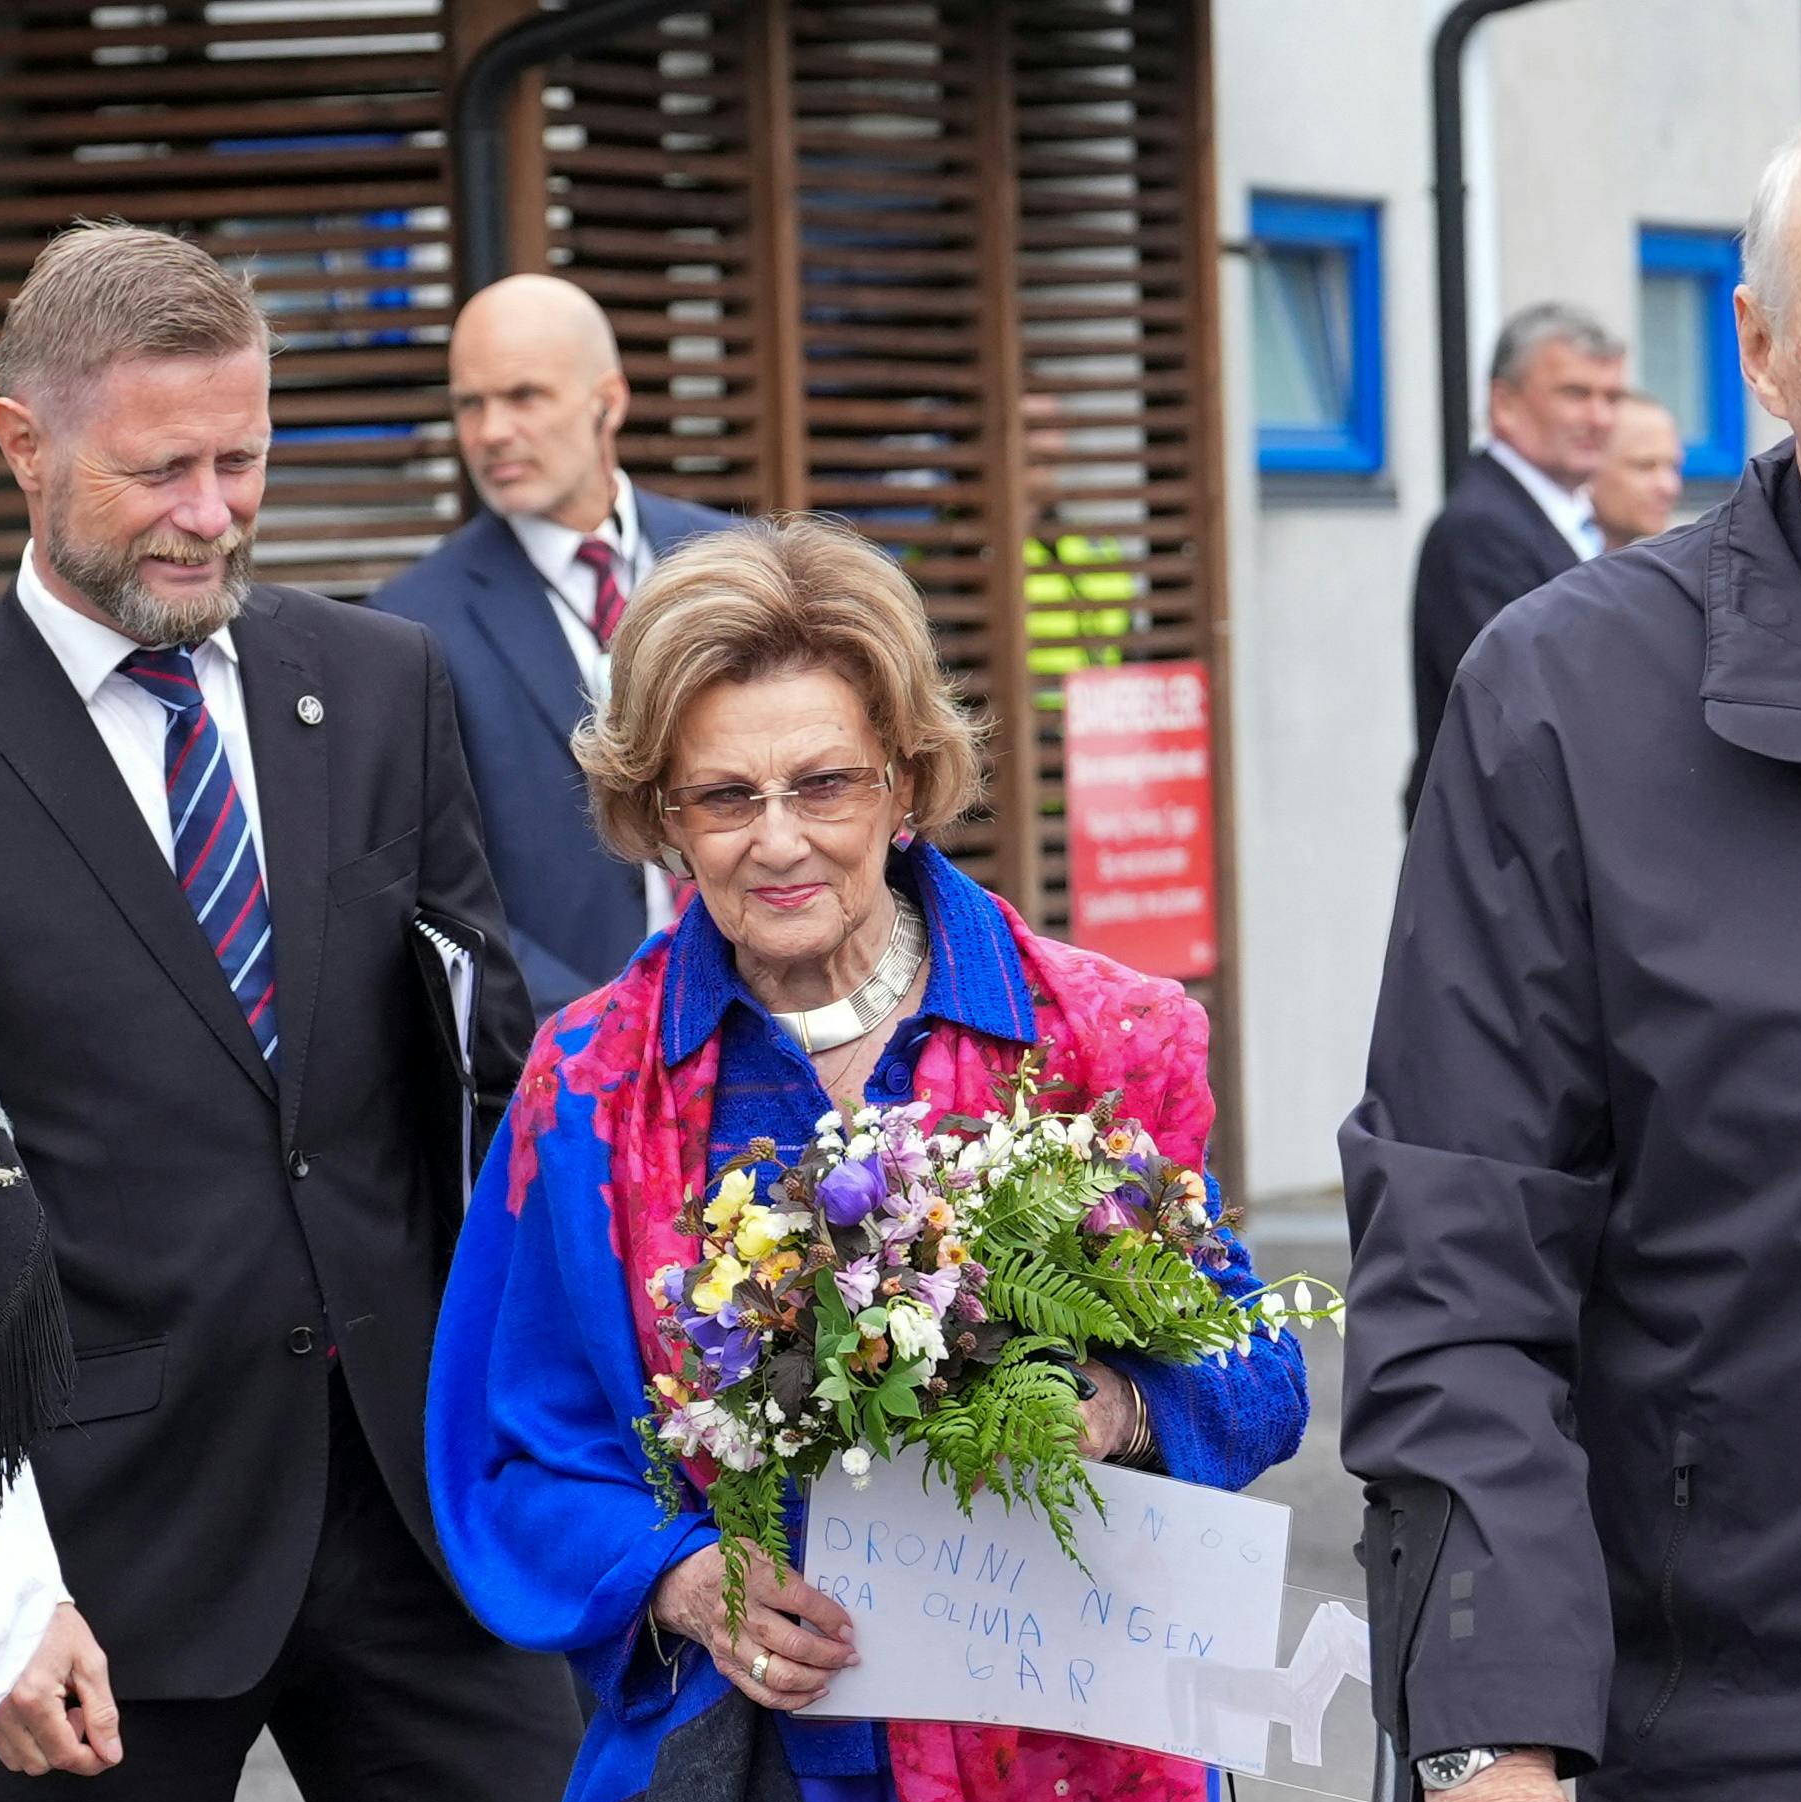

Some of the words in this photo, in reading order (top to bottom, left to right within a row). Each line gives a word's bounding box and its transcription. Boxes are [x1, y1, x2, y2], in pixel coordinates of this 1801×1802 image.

[1200, 1527, 1263, 1565] OG
[816, 1574, 874, 1611] FRA
[923, 1592, 1043, 1649] OLIVIA
